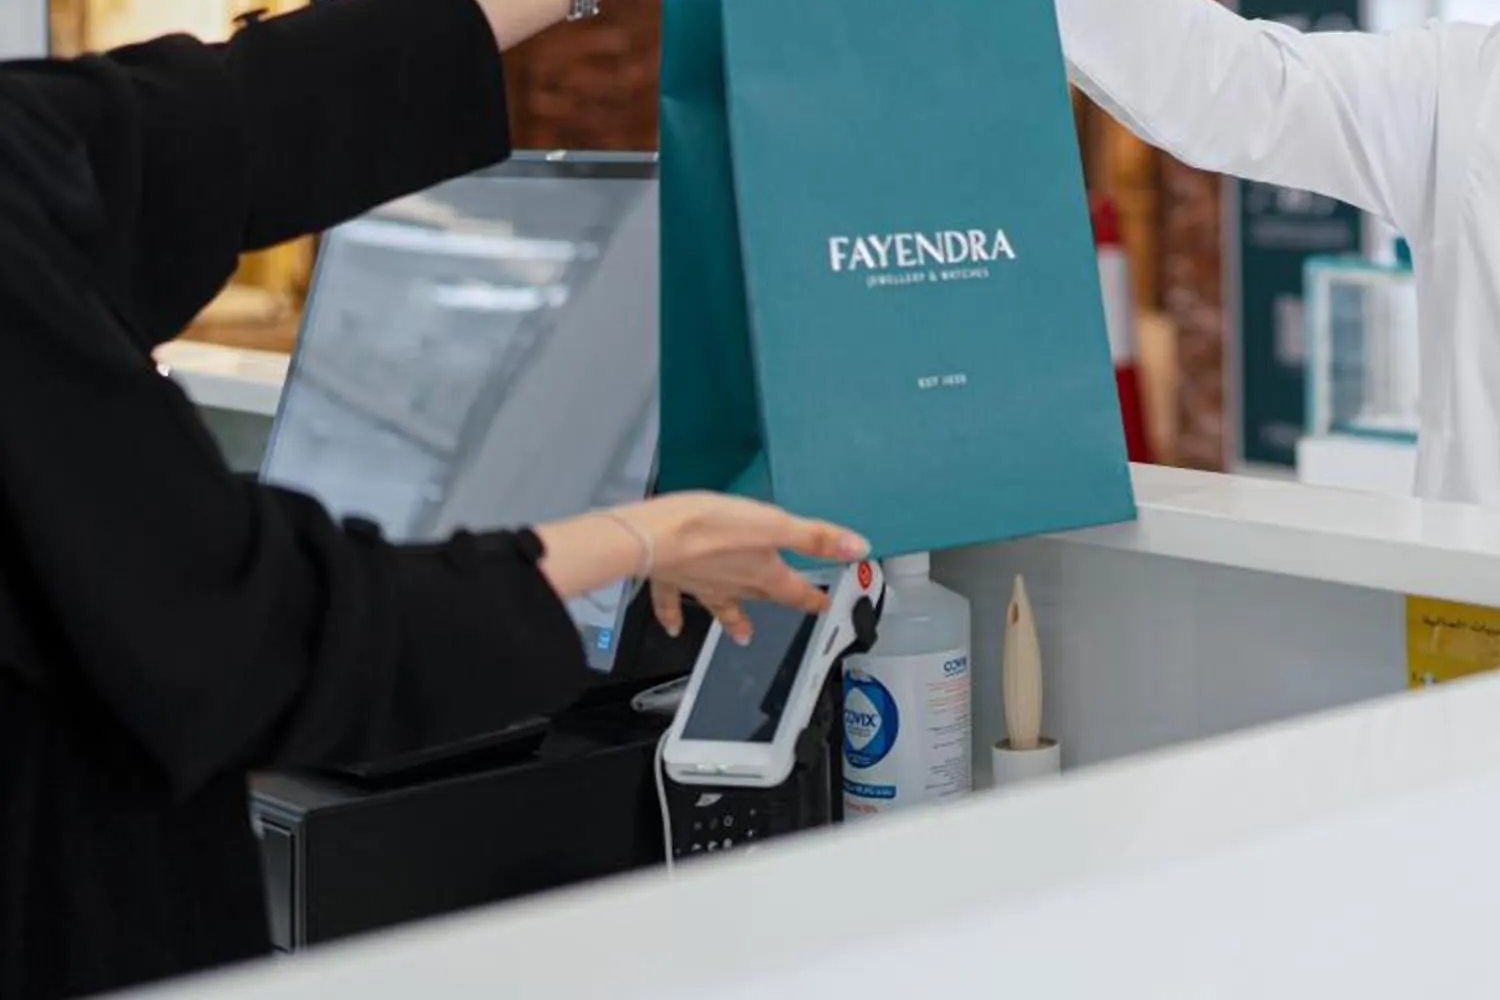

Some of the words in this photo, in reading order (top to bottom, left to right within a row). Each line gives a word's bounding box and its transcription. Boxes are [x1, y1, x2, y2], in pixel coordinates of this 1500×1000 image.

[828, 227, 1017, 272] FAYENDRA
[865, 270, 925, 288] JEWELLERY
[928, 270, 938, 282] &
[941, 266, 990, 281] WATCHES
